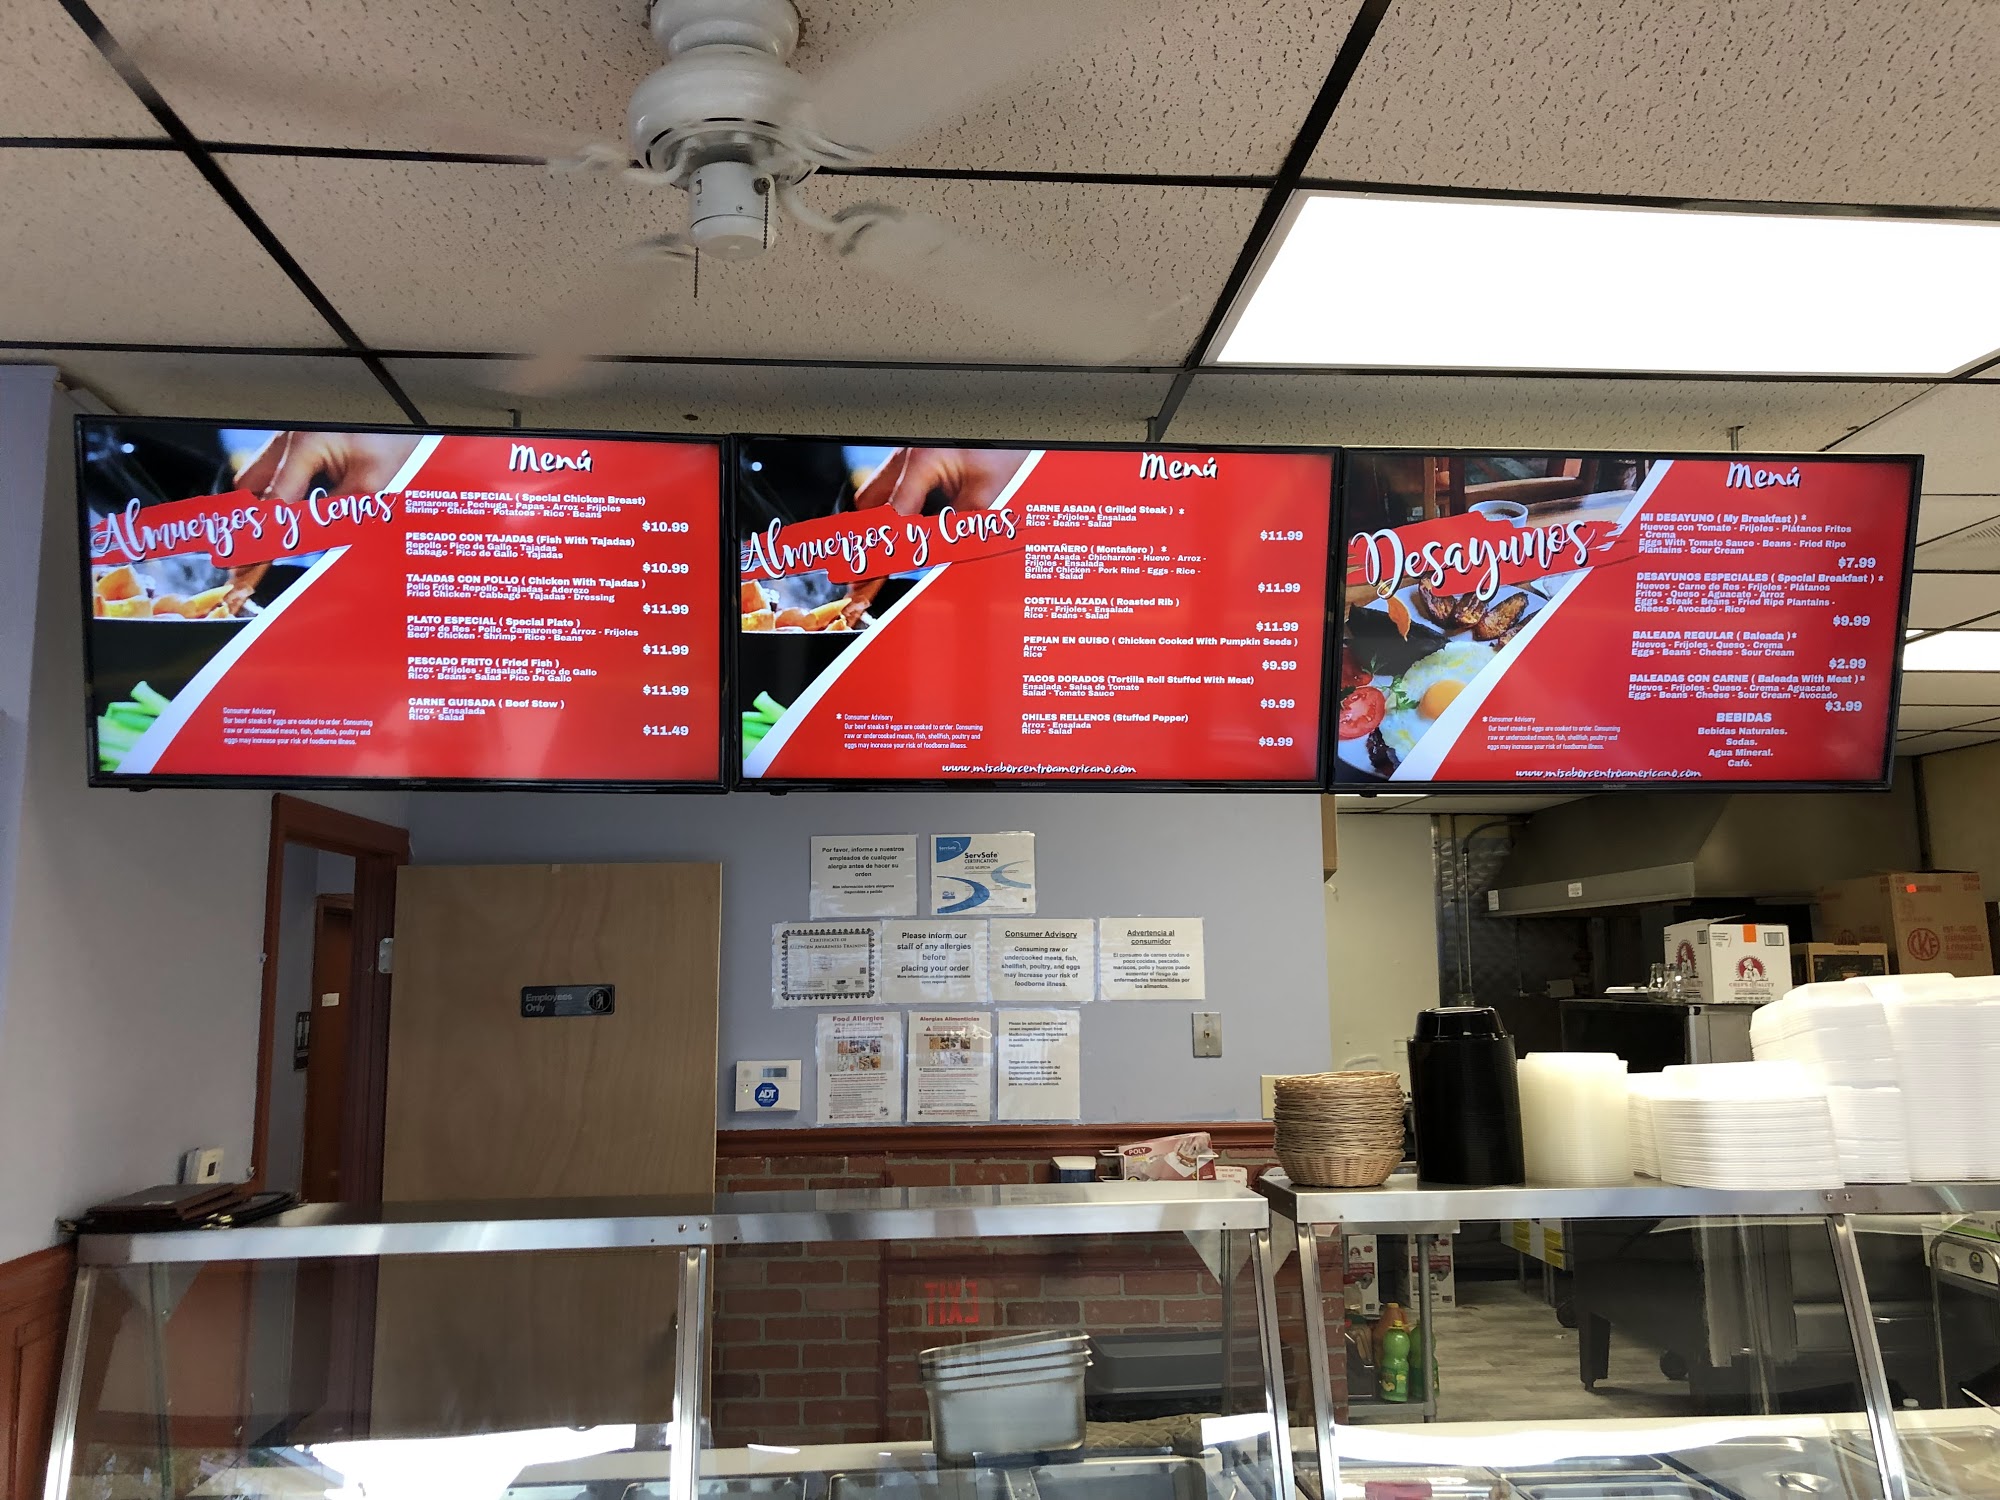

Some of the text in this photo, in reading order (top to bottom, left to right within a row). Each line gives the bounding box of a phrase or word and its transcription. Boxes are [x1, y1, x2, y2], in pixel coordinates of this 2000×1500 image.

[508, 443, 593, 473] Menú
[1139, 452, 1219, 479] Menú
[1725, 461, 1801, 490] Menú
[405, 490, 645, 506] PECHUGA ESPECIAL Special Chicken Breast)
[1105, 505, 1136, 513] Grilled
[90, 486, 396, 562] Almuerzos y Cenas
[1641, 513, 1791, 524] MI DESAYUNO My Breakfast
[643, 521, 688, 532] $10.99
[406, 532, 635, 547] PESCADO CON TAJADAS (Fish With Tajadas)
[1260, 530, 1303, 541] $11.99
[741, 505, 1020, 580] Almuerzos y Cenas
[1026, 544, 1088, 552] MONTAÑERO
[1350, 519, 1597, 602] Desayunos
[1838, 557, 1876, 568] $7.99
[643, 562, 688, 573] $10.99
[1637, 572, 1867, 583] DESAYUNOS ESPECIALES Special Breakfast
[1258, 582, 1300, 593] $11.99
[643, 603, 689, 614] $11.99
[407, 616, 574, 628] PLATO ESPECIAL Special Plate
[1833, 615, 1870, 626] $9.99
[1256, 621, 1298, 632] $11.99
[1220, 638, 1260, 646] Pumpkin
[643, 644, 689, 655] $11.99
[1262, 660, 1296, 670] $9.99
[1829, 658, 1866, 669] $2.99
[1107, 676, 1144, 686] (Tortilla
[1228, 676, 1254, 685] Meat)
[643, 685, 689, 695] $11.99
[1261, 699, 1295, 709] $9.99
[1825, 701, 1862, 712] $3.99
[1113, 714, 1150, 722] (Stuffed
[1153, 714, 1188, 723] Pepper)
[1717, 713, 1771, 722] BEBIDAS
[643, 725, 688, 735] $11.49
[1259, 736, 1293, 747] $9.99
[1708, 749, 1732, 758] Agua
[870, 854, 897, 862] cualquier
[1045, 931, 1077, 939] Advisory
[940, 943, 971, 951] allergies
[901, 965, 928, 973] placing
[526, 993, 573, 1003] Employees
[526, 1004, 546, 1013] Only
[758, 1090, 776, 1098] ADT
[1128, 1147, 1147, 1155] POLY
